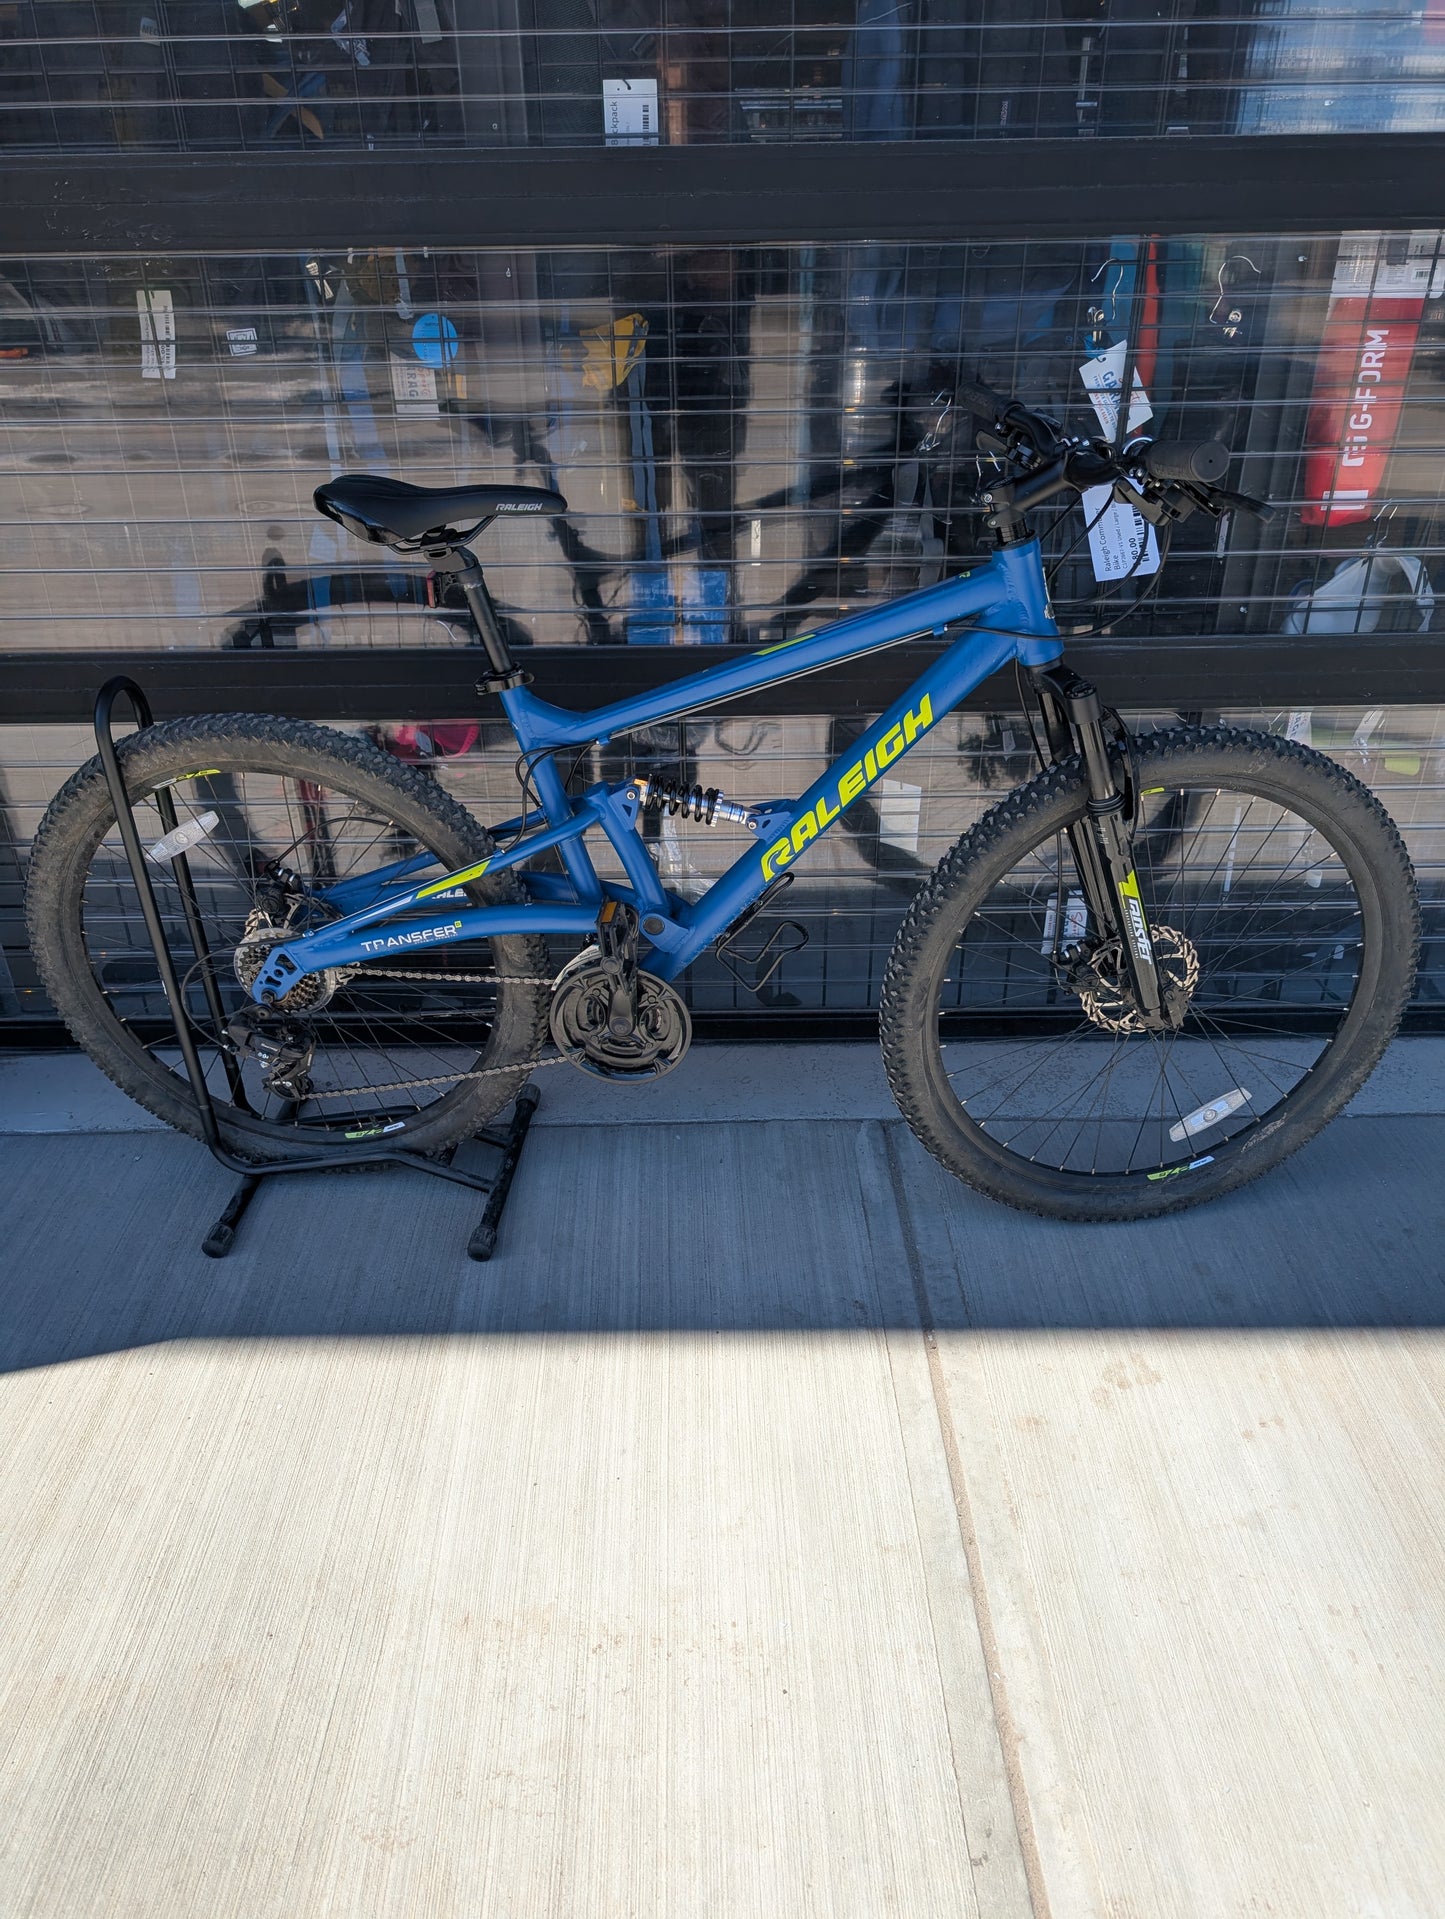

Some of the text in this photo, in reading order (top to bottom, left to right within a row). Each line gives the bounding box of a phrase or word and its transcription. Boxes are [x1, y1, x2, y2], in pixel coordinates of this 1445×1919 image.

[610, 100, 620, 146] Bckpack
[495, 503, 543, 511] RALEIGH
[1100, 545, 1112, 572] Raleigh
[1113, 555, 1121, 570] Bike
[760, 692, 934, 883] RALEIGH
[360, 923, 457, 952] TRANSFER
